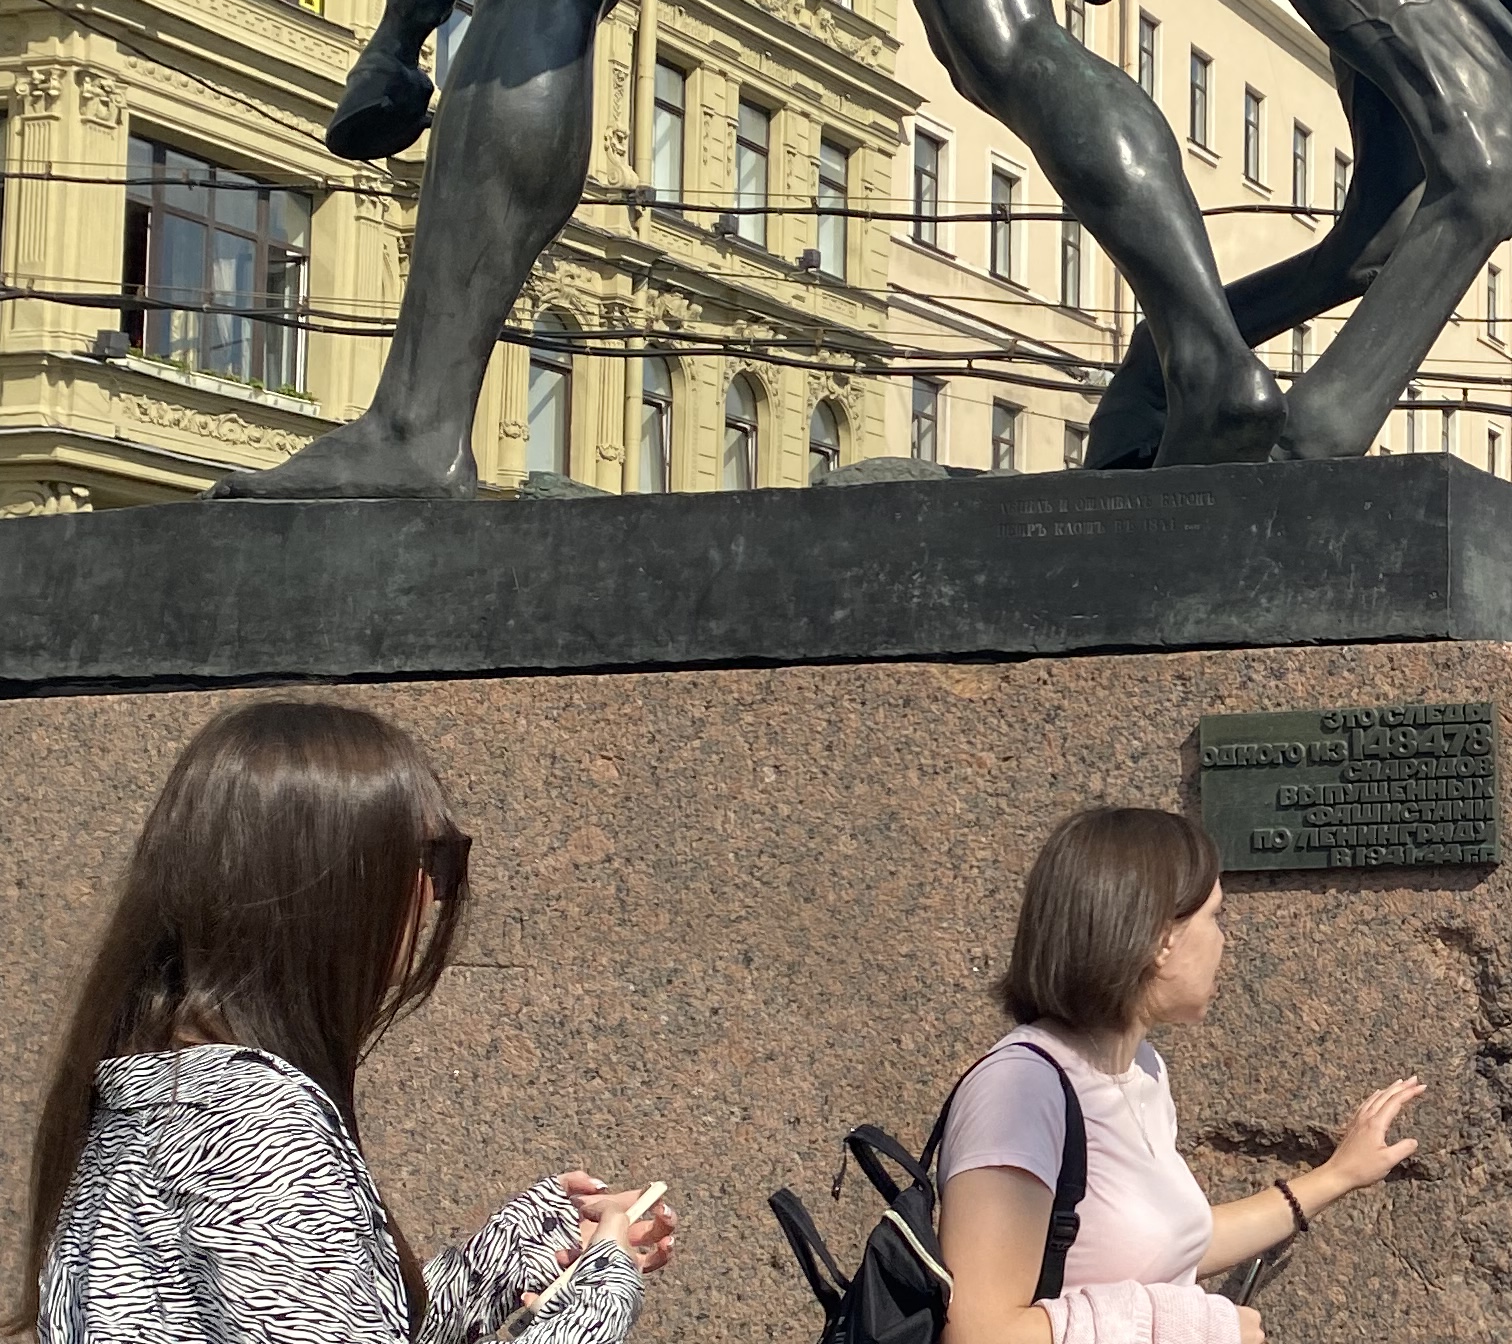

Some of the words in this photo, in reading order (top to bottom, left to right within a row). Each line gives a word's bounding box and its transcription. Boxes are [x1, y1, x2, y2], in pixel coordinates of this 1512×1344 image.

[1323, 708, 1378, 729] ЭТО
[1383, 704, 1493, 726] СЛЕДЫ
[1201, 742, 1306, 767] ОДНОГО
[1310, 740, 1349, 762] ИЗ
[1351, 723, 1493, 760] 148478
[1343, 757, 1494, 781] СНАРЯДОВ
[1279, 778, 1494, 806] ВЫПУЩЕННЫХ
[1305, 800, 1494, 825] ФАШИСТАМИ
[1253, 828, 1293, 849] ПО
[1295, 821, 1495, 850] ЛЕНИНГРАДУ
[1330, 847, 1351, 866] В
[1355, 843, 1461, 865] 1941-44
